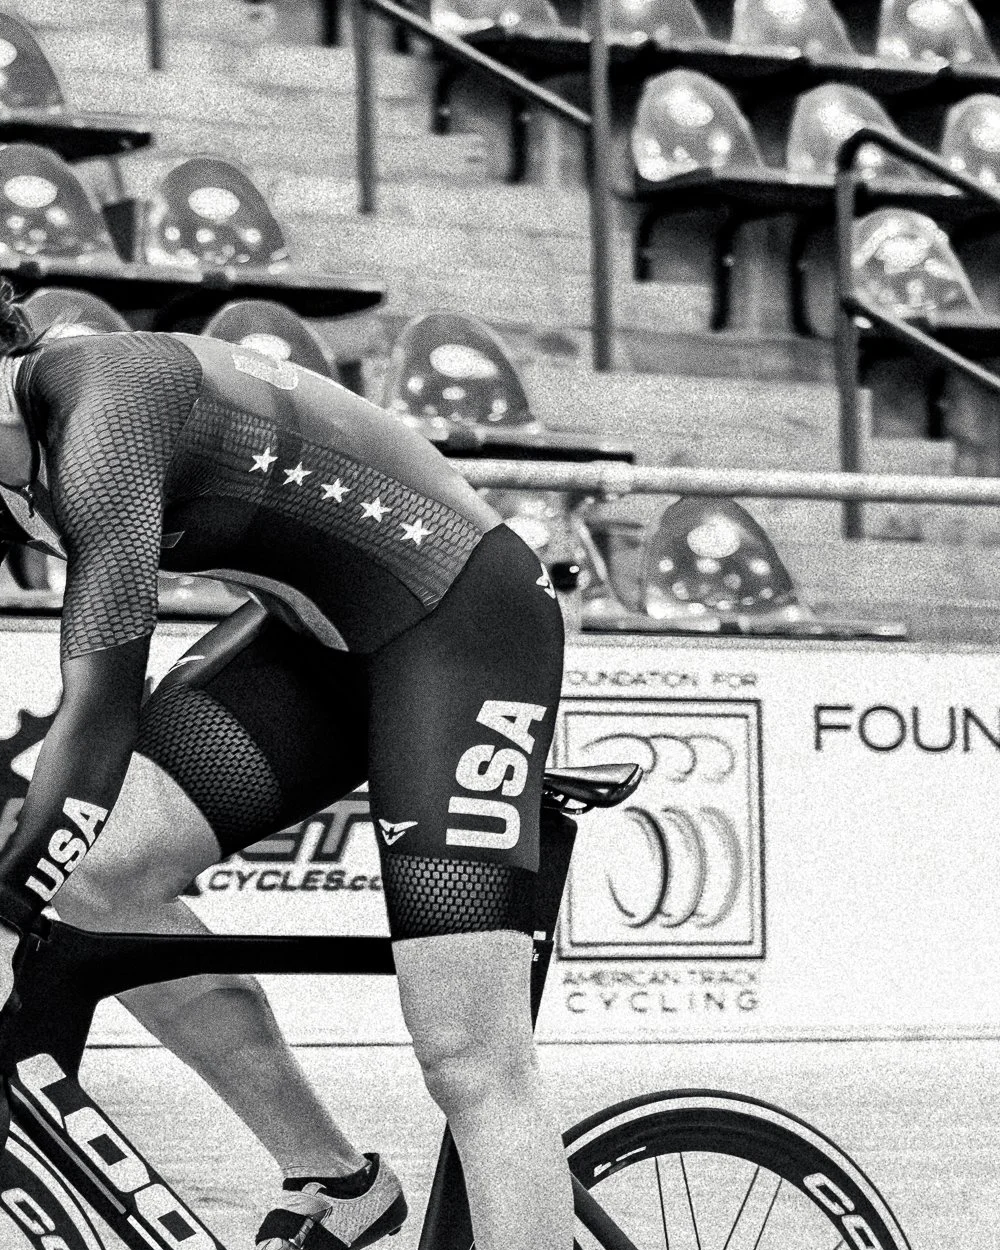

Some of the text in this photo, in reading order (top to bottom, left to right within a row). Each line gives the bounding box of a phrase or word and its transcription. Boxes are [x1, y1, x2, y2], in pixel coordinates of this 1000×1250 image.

[566, 670, 698, 688] OUNDATION
[445, 699, 548, 851] USA
[25, 797, 110, 901] USA
[207, 869, 382, 892] CYCLES.co
[565, 989, 760, 1014] CYCLING
